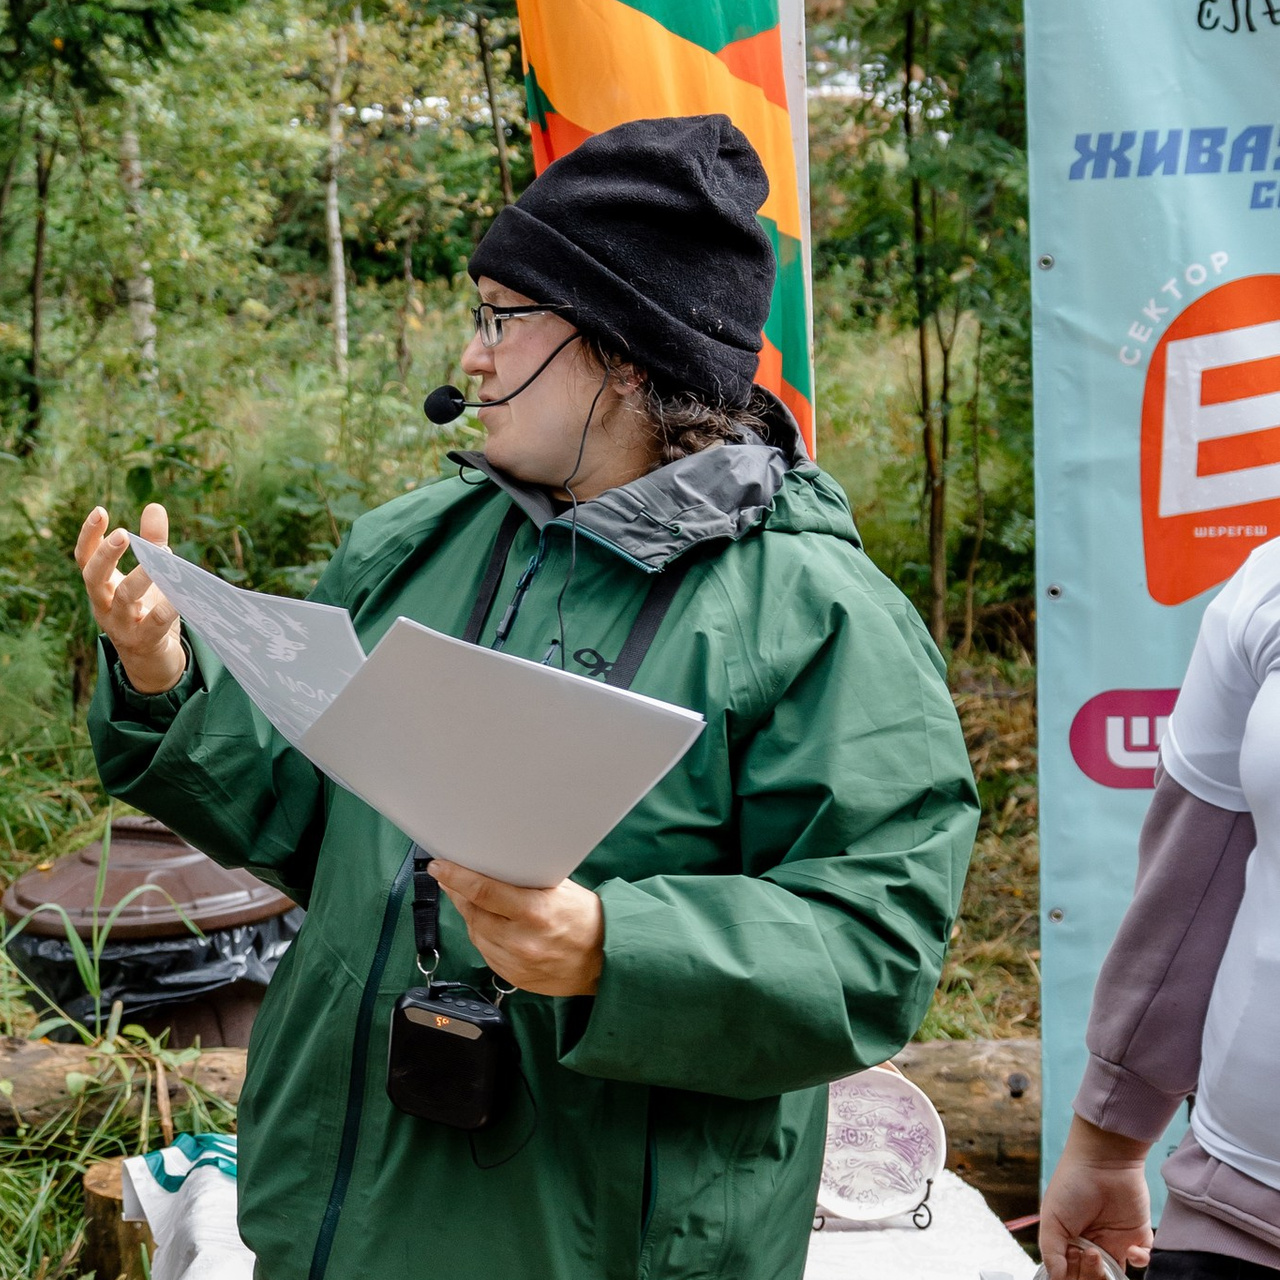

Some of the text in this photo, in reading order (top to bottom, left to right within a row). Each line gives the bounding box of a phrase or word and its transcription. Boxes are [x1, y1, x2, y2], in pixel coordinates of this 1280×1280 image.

[1068, 124, 1280, 180] ЖИВА
[1119, 250, 1229, 366] СЕКТОР
[1193, 525, 1268, 538] ШЕРЕГЕШ
